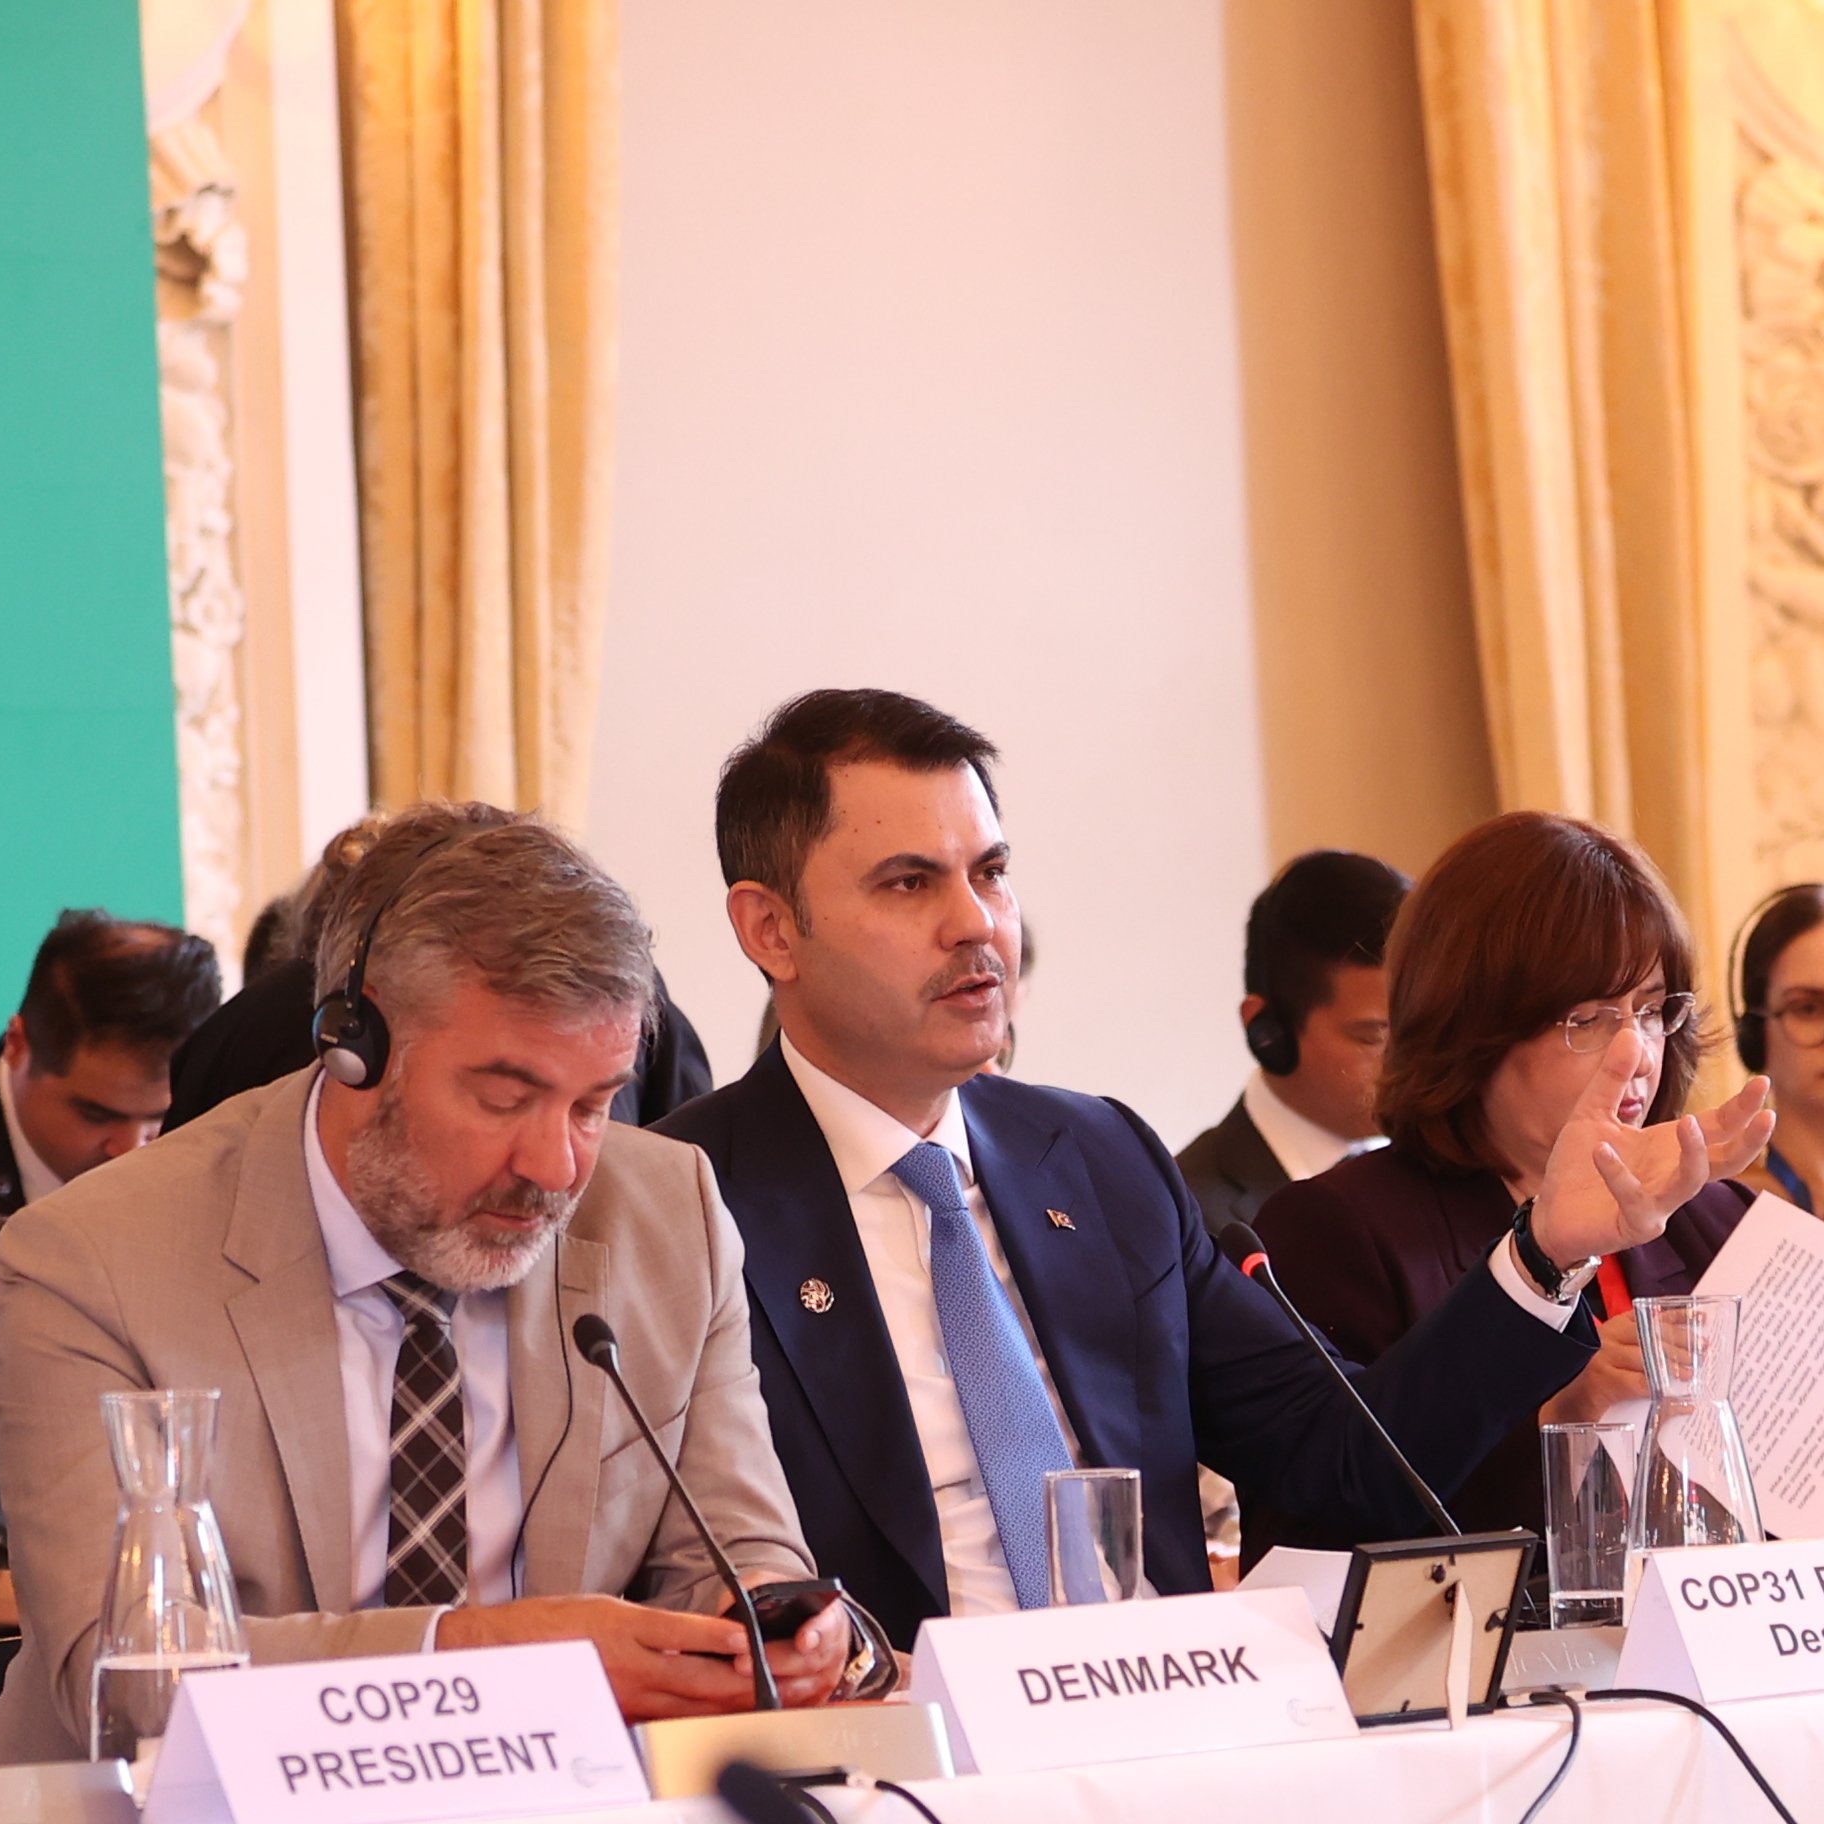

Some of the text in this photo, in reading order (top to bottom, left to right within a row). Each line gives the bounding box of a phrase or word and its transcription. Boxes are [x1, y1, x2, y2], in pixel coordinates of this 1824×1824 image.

[1679, 1566, 1806, 1613] COP31
[318, 1675, 482, 1727] COP29
[1016, 1645, 1261, 1708] DENMARK
[278, 1731, 560, 1795] PRESIDENT
